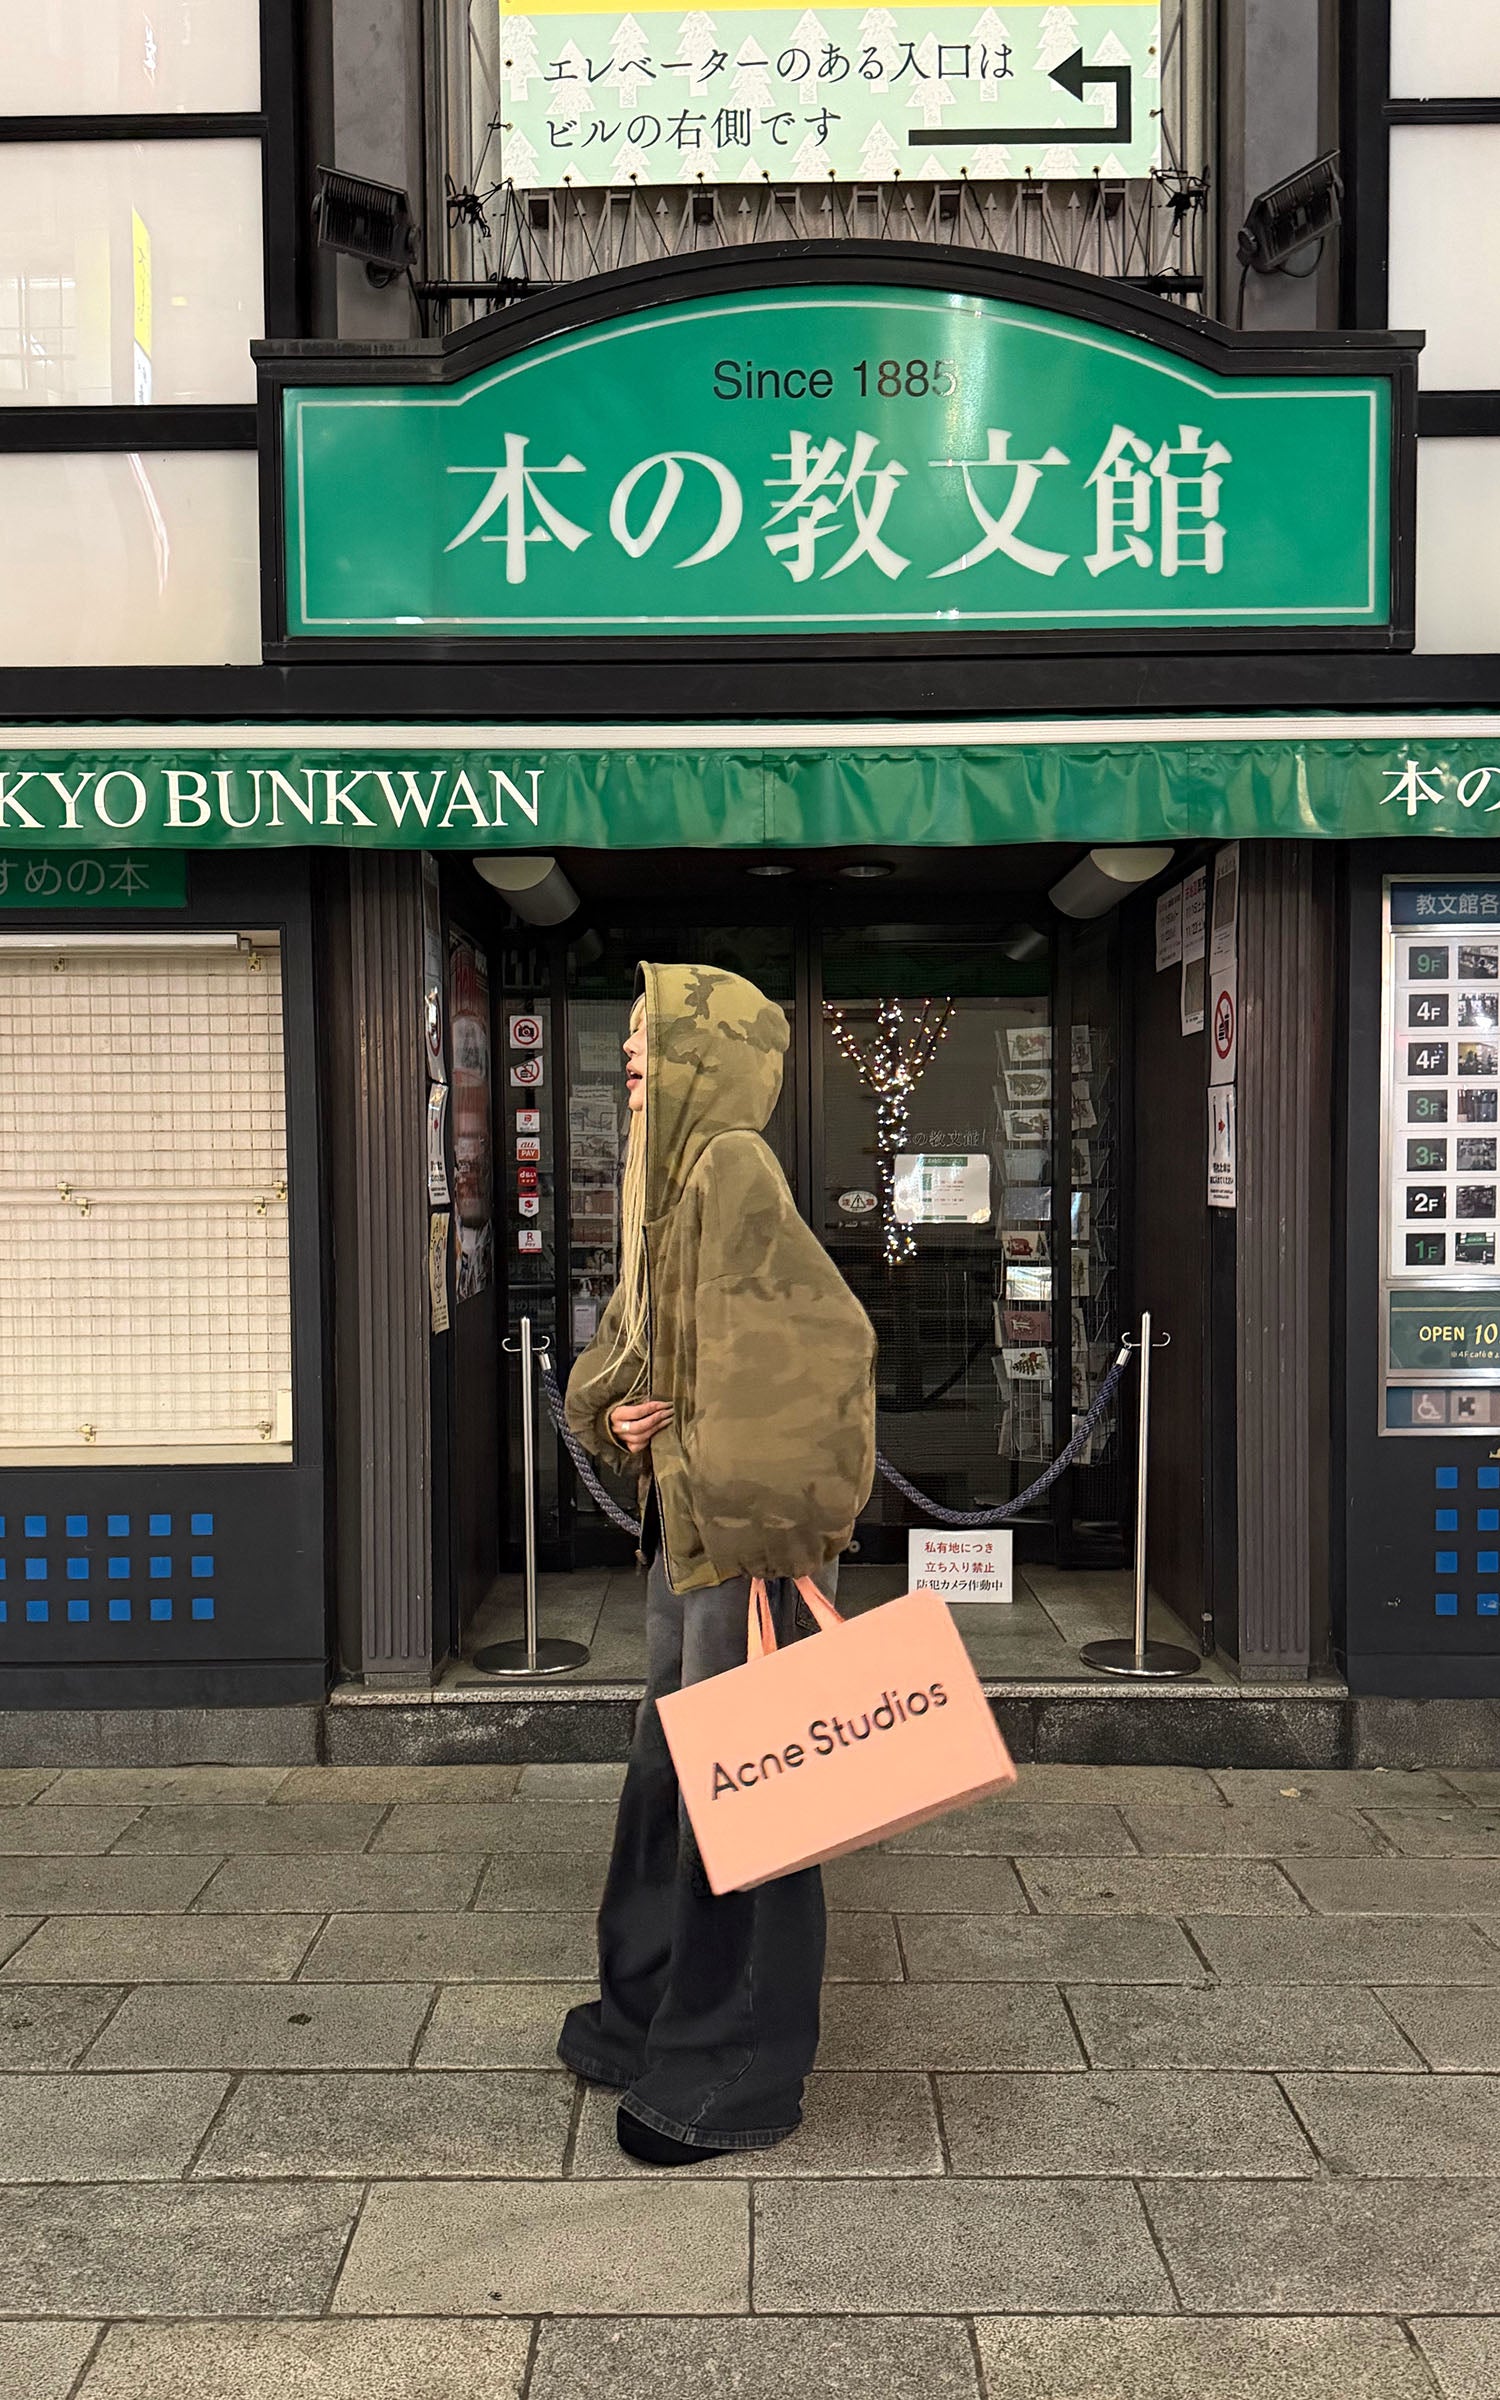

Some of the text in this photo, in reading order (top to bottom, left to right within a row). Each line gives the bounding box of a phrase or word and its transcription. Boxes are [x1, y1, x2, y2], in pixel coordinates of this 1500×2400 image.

[543, 41, 1014, 84] エレベーターのある入口は
[545, 106, 842, 149] ビルの右側です
[713, 359, 958, 400] Since 1885
[443, 424, 1234, 585] 本の教文館
[162, 768, 546, 829] BUNKWAN
[1416, 893, 1500, 916] 教文館各
[1416, 954, 1441, 974] 9F
[1416, 1001, 1441, 1021] 4F
[1416, 1050, 1440, 1069] 4F
[1415, 1097, 1439, 1117] 3F
[1415, 1146, 1439, 1166] 3F
[1414, 1193, 1439, 1212] 2F
[1415, 1240, 1438, 1260] 1F
[1419, 1323, 1500, 1345] OPEN 10
[924, 1541, 994, 1554] 私有地につき
[924, 1561, 996, 1574] 立ち入り禁止
[916, 1579, 1003, 1592] 防犯カメラ作動中
[711, 1681, 949, 1801] Acne Studios
